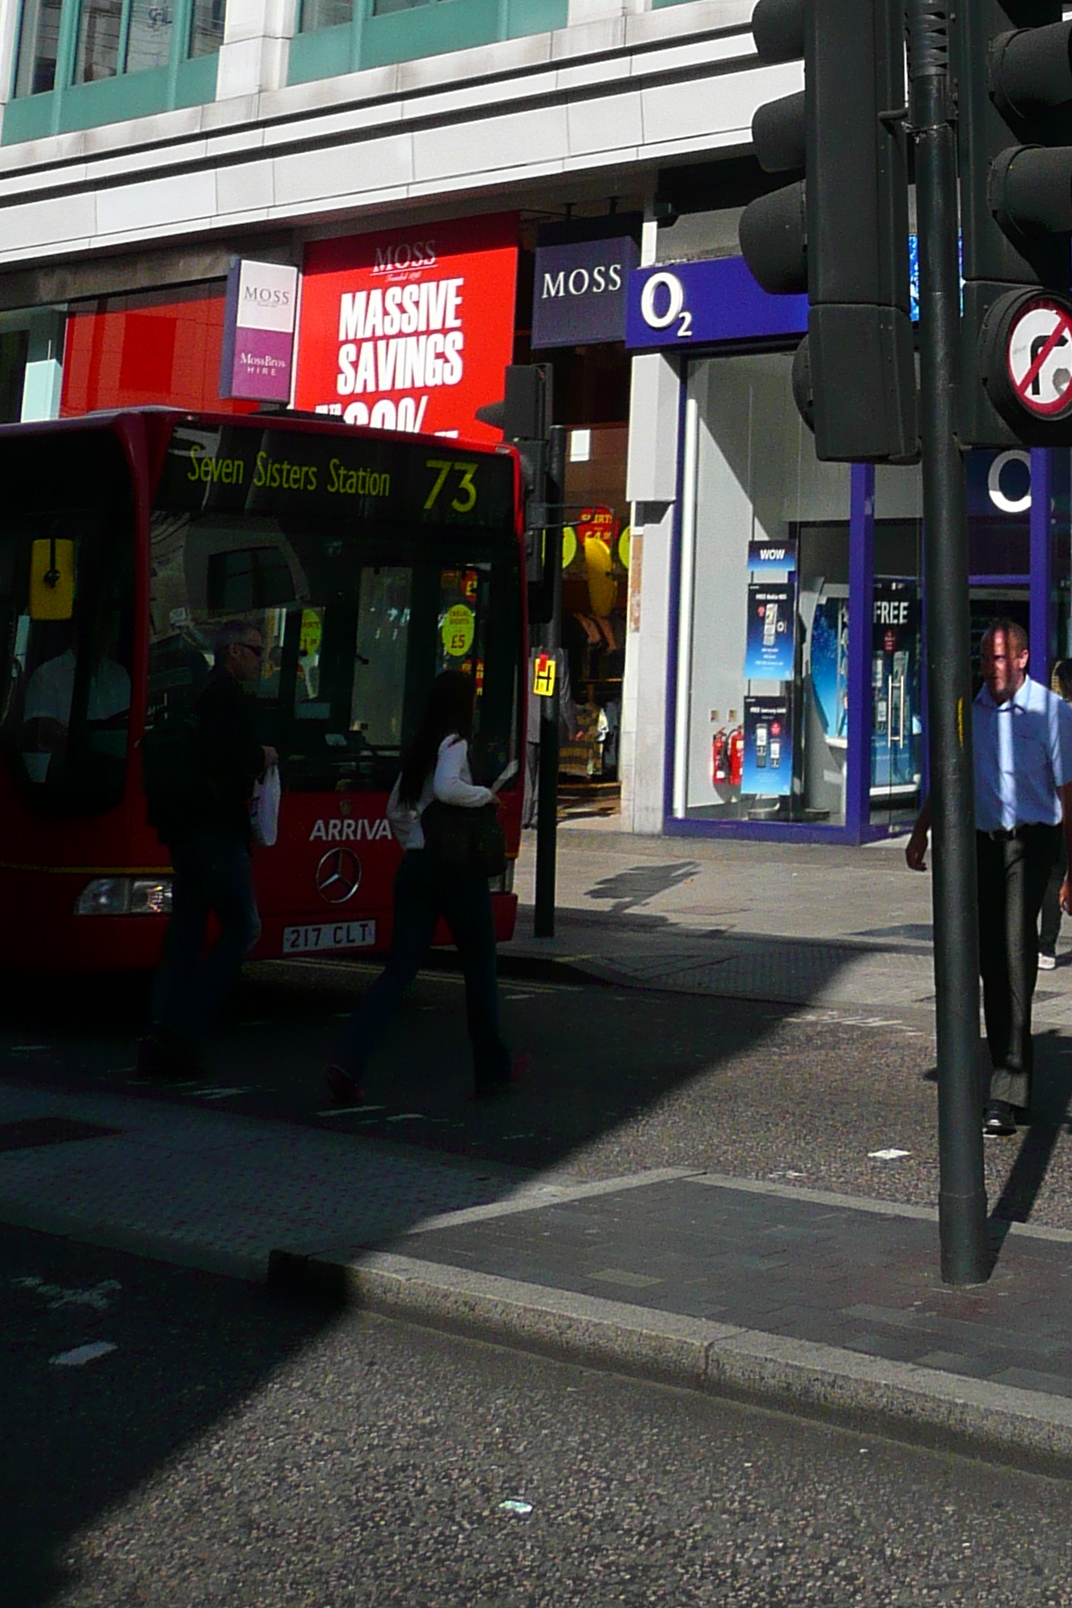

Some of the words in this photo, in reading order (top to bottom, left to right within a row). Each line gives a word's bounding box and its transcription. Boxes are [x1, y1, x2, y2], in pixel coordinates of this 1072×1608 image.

[373, 240, 437, 273] MOSS
[541, 264, 622, 299] MOSS
[244, 285, 290, 305] MOSS
[338, 278, 464, 342] MASSIVE
[247, 366, 277, 377] HIRE
[336, 331, 464, 395] SAVINGS
[187, 445, 244, 485] Seven
[253, 451, 317, 491] Sisters
[327, 458, 391, 497] Station
[423, 459, 479, 513] 73
[759, 549, 786, 560] WOW
[873, 601, 910, 624] FREE
[451, 634, 466, 649] £5
[309, 818, 393, 842] ARRIVA
[290, 926, 322, 949] 217
[333, 923, 369, 944] CLT
